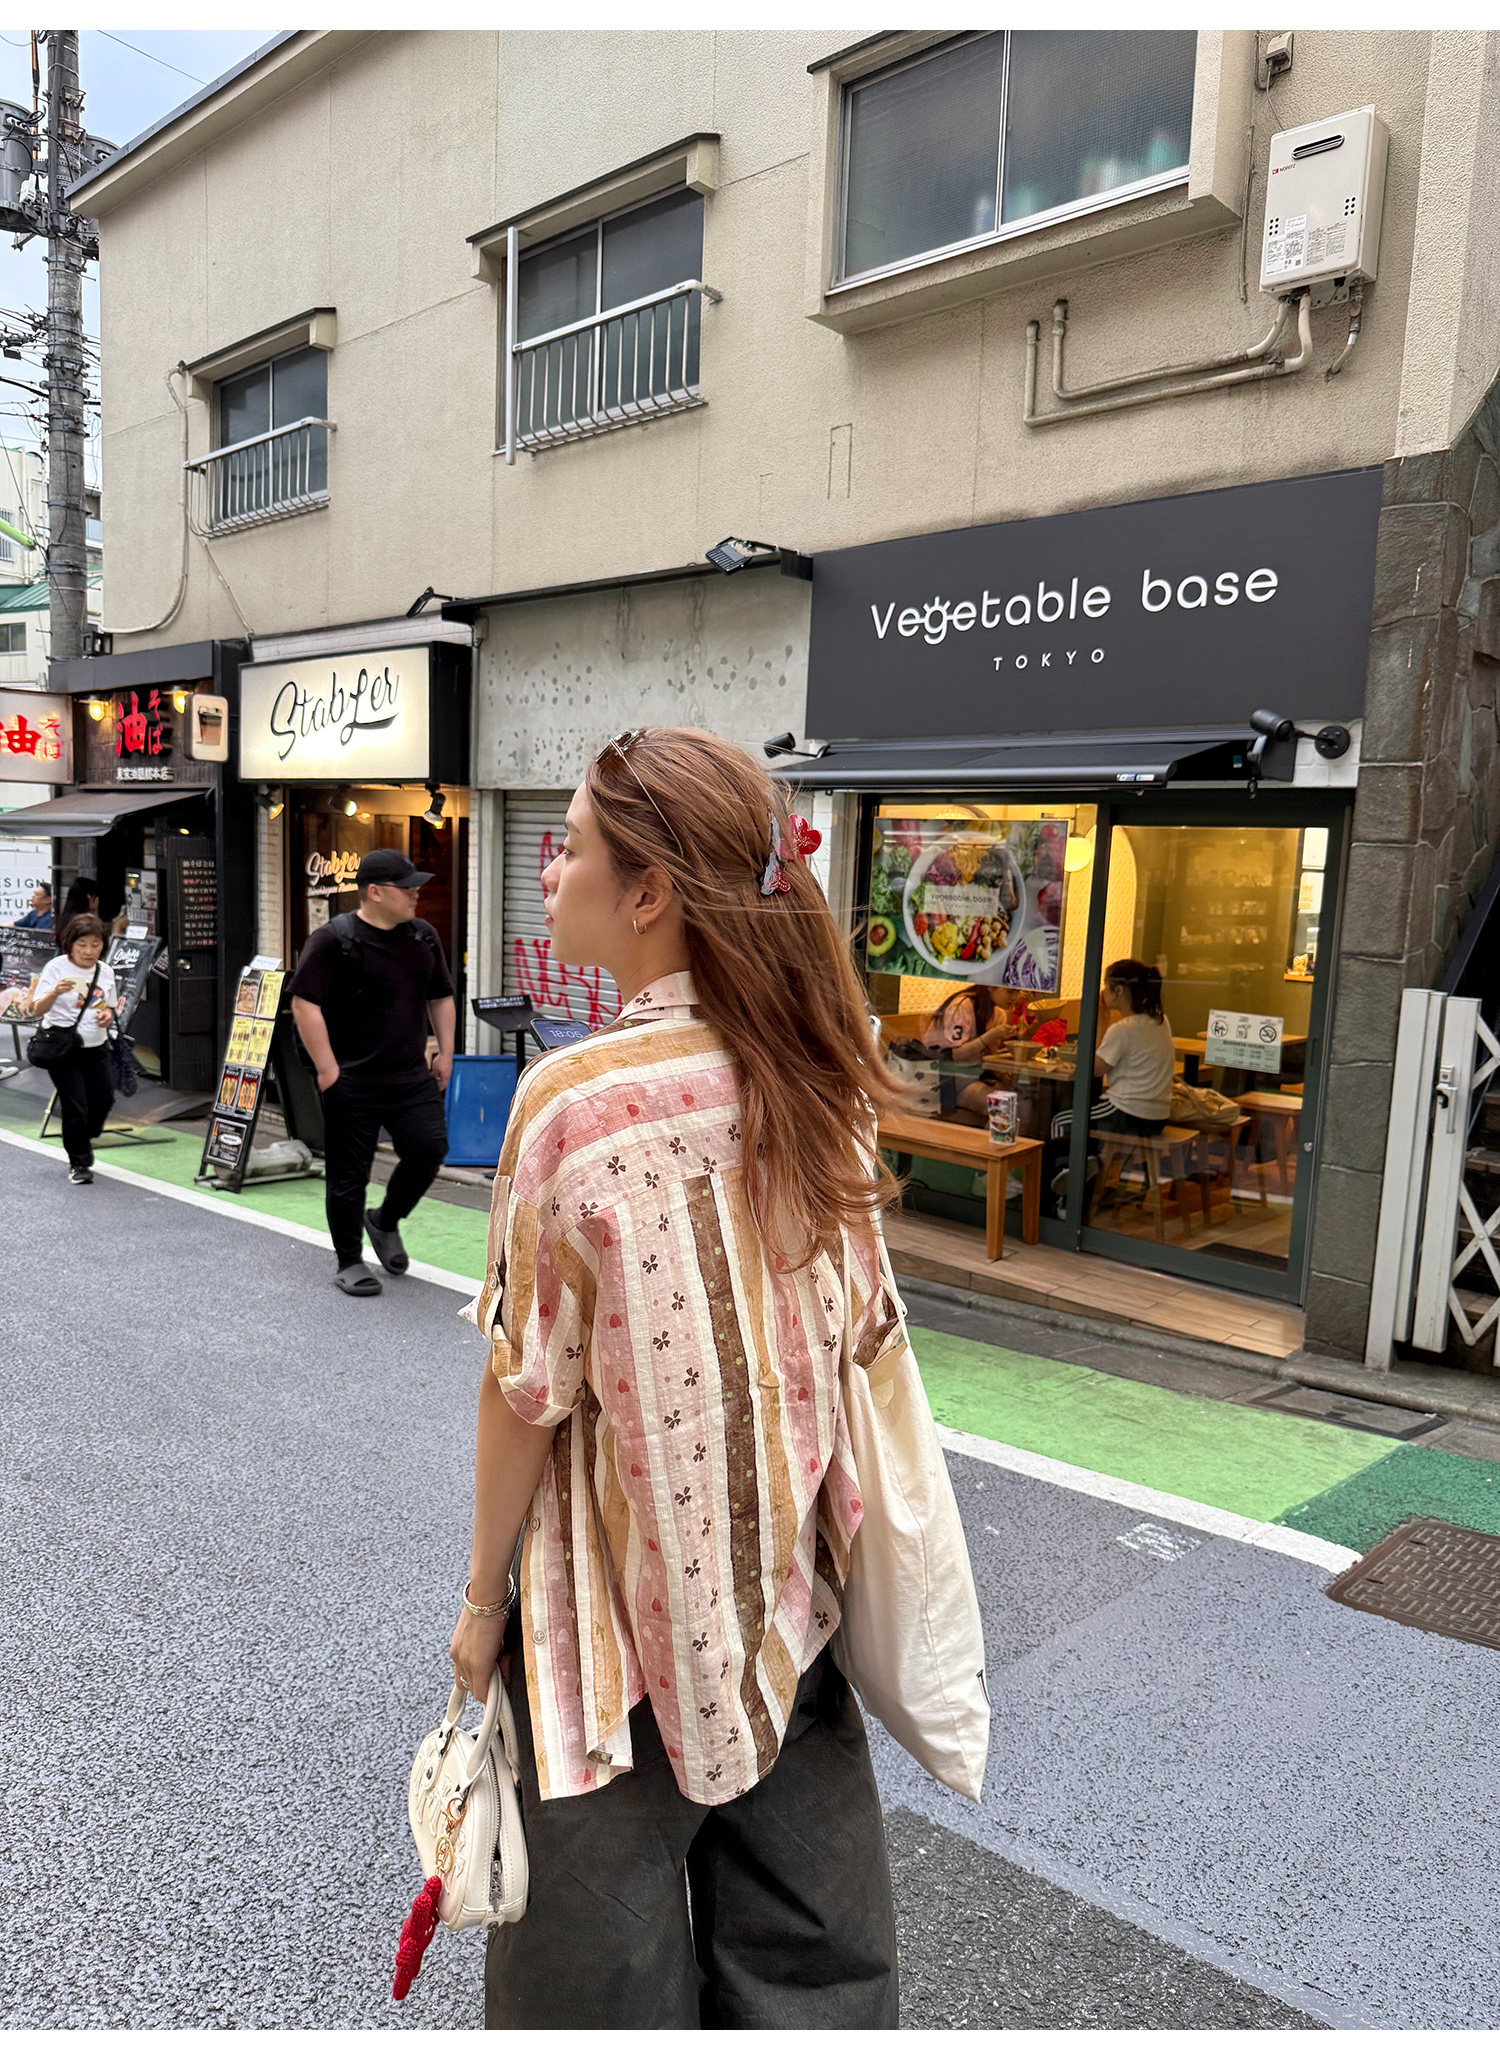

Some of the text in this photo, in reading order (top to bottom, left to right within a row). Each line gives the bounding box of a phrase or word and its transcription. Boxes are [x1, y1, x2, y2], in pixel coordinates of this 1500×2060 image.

[870, 568, 1279, 645] Vegetable base
[993, 649, 1105, 671] TOKYO
[549, 1029, 584, 1040] 18:05
[952, 1025, 963, 1041] 3
